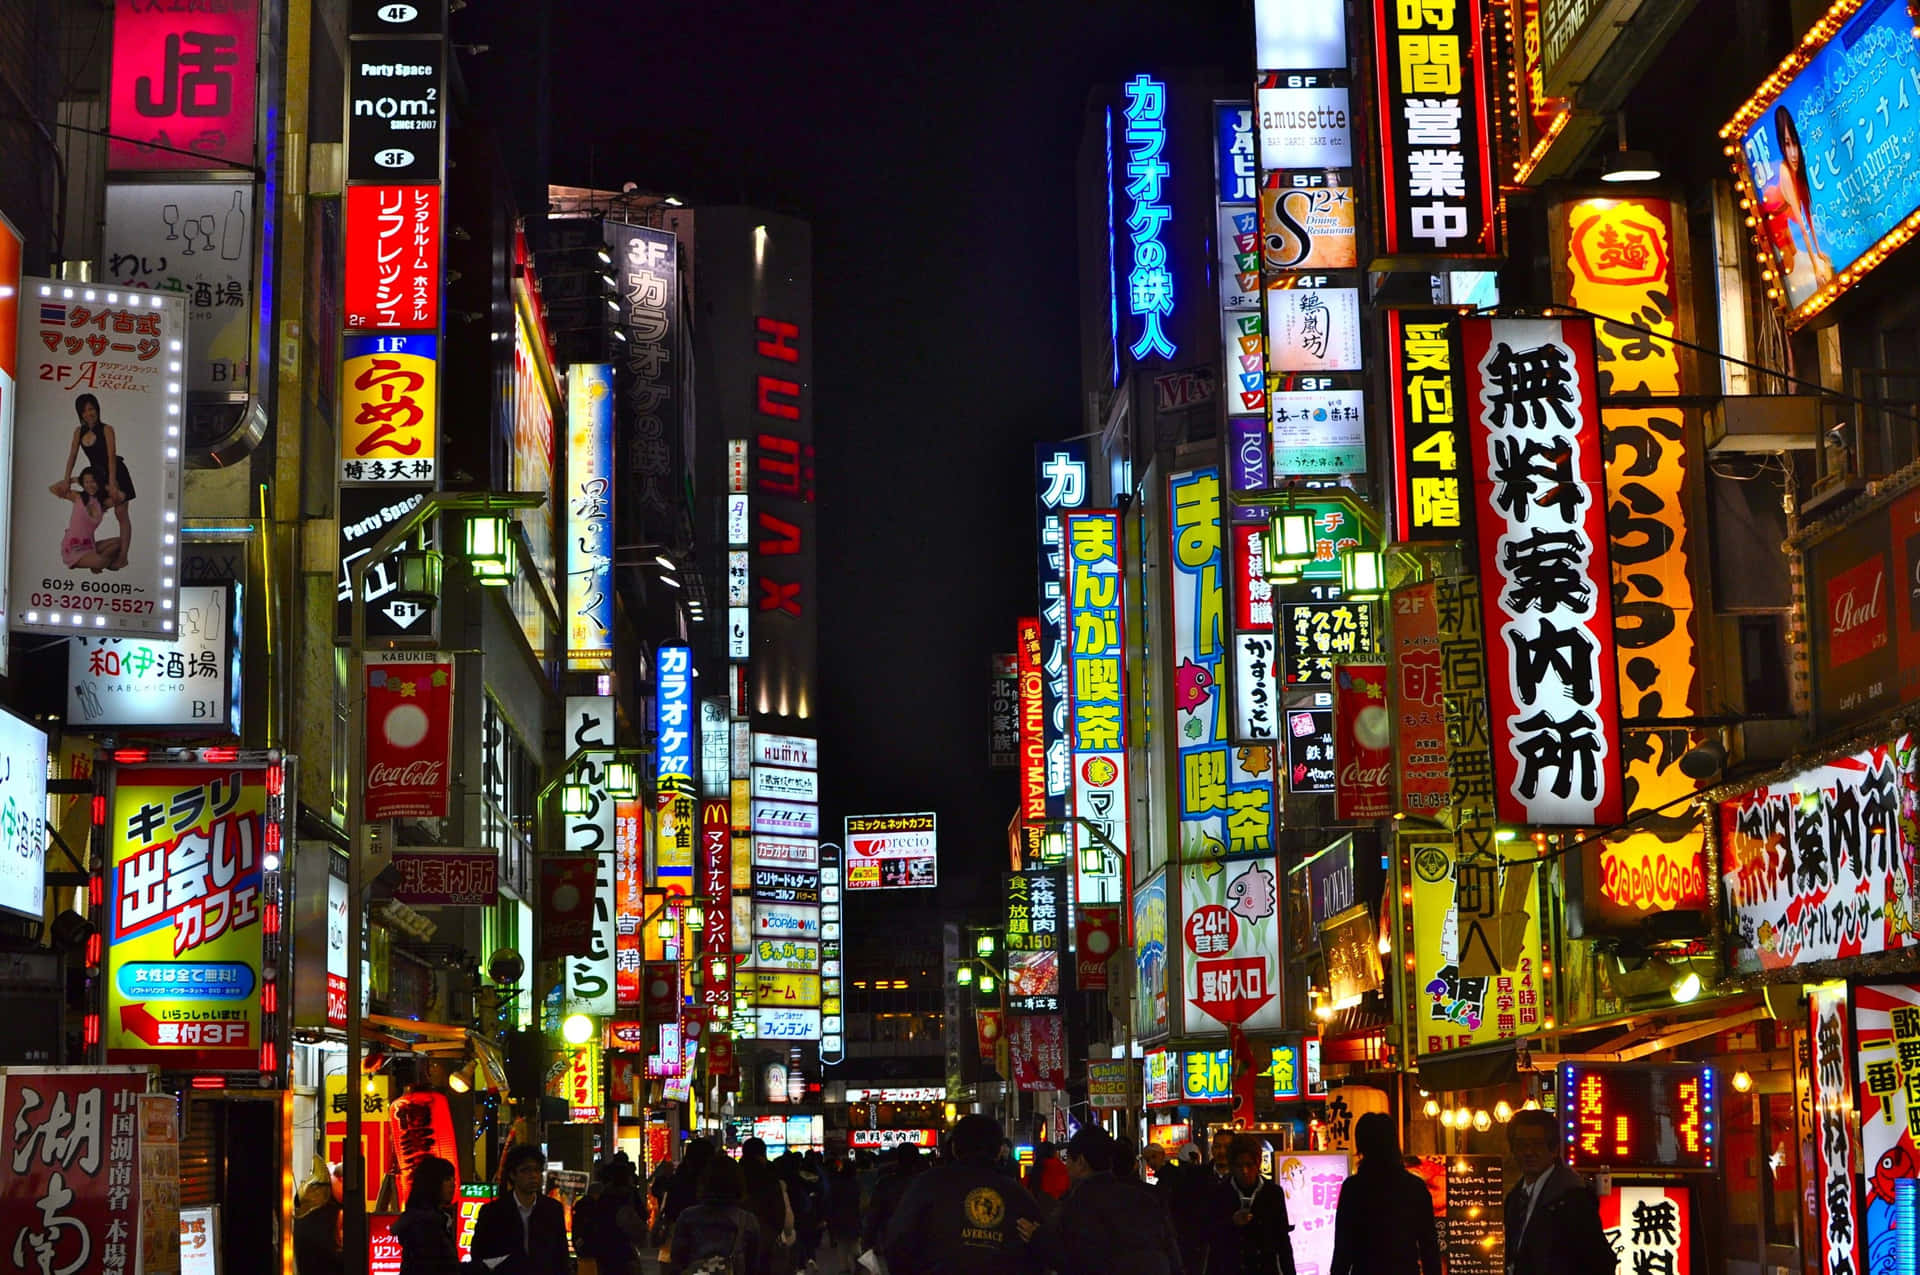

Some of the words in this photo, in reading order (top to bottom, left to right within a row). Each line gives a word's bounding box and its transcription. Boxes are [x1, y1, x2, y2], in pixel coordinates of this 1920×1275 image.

[387, 8, 407, 20] 4F
[362, 64, 393, 78] Party
[395, 64, 432, 78] Space
[1287, 75, 1318, 88] 6F
[391, 120, 415, 130] SINCE
[416, 120, 436, 130] 2007
[1263, 105, 1347, 130] amusette
[385, 153, 405, 164] 3F
[1748, 125, 1775, 190] 3F
[1292, 175, 1323, 187] 5F
[413, 190, 429, 269] レンタルルーム
[1124, 74, 1177, 361] カラオケの鉄人
[1306, 215, 1338, 226] Dining
[1306, 226, 1354, 236] Restaurant
[109, 253, 168, 277] わい
[376, 190, 405, 327] リフレッシュ
[628, 238, 669, 266] 3F
[1233, 211, 1258, 294] カラオケ
[1297, 276, 1328, 288] 4F
[413, 277, 428, 321] ホステル
[69, 305, 162, 337] タイ古式
[349, 315, 367, 326] 2F
[40, 330, 161, 361] マッサージ
[376, 337, 407, 352] 1F
[40, 363, 72, 382] 2F
[64, 361, 134, 391] Asian
[1237, 317, 1265, 411] ビッグワン
[1301, 378, 1332, 390] 3F
[1276, 407, 1311, 424] あーす
[1330, 407, 1360, 423] 歯科
[1404, 322, 1461, 528] 受付4階
[344, 461, 432, 480] 博多天神
[1240, 430, 1263, 490] ROYA
[343, 507, 382, 541] Party
[42, 578, 75, 591] 60分
[1485, 342, 1603, 803] 無料案内所
[31, 592, 155, 615] 03-3207-5527
[1311, 586, 1341, 600] 1F
[1397, 597, 1425, 615] 2F
[1832, 570, 1883, 636] Real
[394, 604, 417, 617] B1
[1068, 517, 1122, 751] まんが喫茶
[1330, 605, 1358, 653] 九州
[88, 646, 218, 679] 和伊酒場
[660, 648, 688, 753] カラオケ
[1244, 637, 1273, 738] かすうどん
[191, 701, 217, 719] B1
[368, 760, 444, 789] Coca-Cola
[659, 755, 689, 772] 747
[127, 772, 243, 844] キラリ
[757, 808, 817, 823] FACE
[674, 798, 692, 850] 麻雀
[848, 818, 934, 831] コミック&ネットカフェ
[1736, 760, 1899, 909] 無料案内所
[119, 809, 255, 932] 出会い
[756, 871, 817, 888] ビリヤード&ダーツ
[1008, 875, 1030, 934] 食べ放題
[1031, 876, 1057, 934] 本格焼肉
[1321, 867, 1353, 917] ROYAL
[173, 884, 259, 956] カフェ
[1192, 911, 1231, 936] 24H
[1777, 893, 1885, 957] ファイナルアンサー
[758, 941, 817, 962] まんが喫茶
[1194, 934, 1229, 953] 営業
[136, 968, 237, 983] 女性は全て無料!
[1201, 967, 1262, 1003] 受付入口
[759, 985, 797, 1001] ゲーム
[1518, 957, 1537, 1025] 24時間
[158, 1023, 246, 1044] 受付3F
[763, 1022, 813, 1037] フィンランド
[1863, 1039, 1899, 1123] 一番!
[859, 1089, 897, 1101] コーヒー
[1329, 1095, 1353, 1142] 九州
[108, 1089, 136, 1211] 中国湖南省
[854, 1130, 921, 1144] 無料案内所
